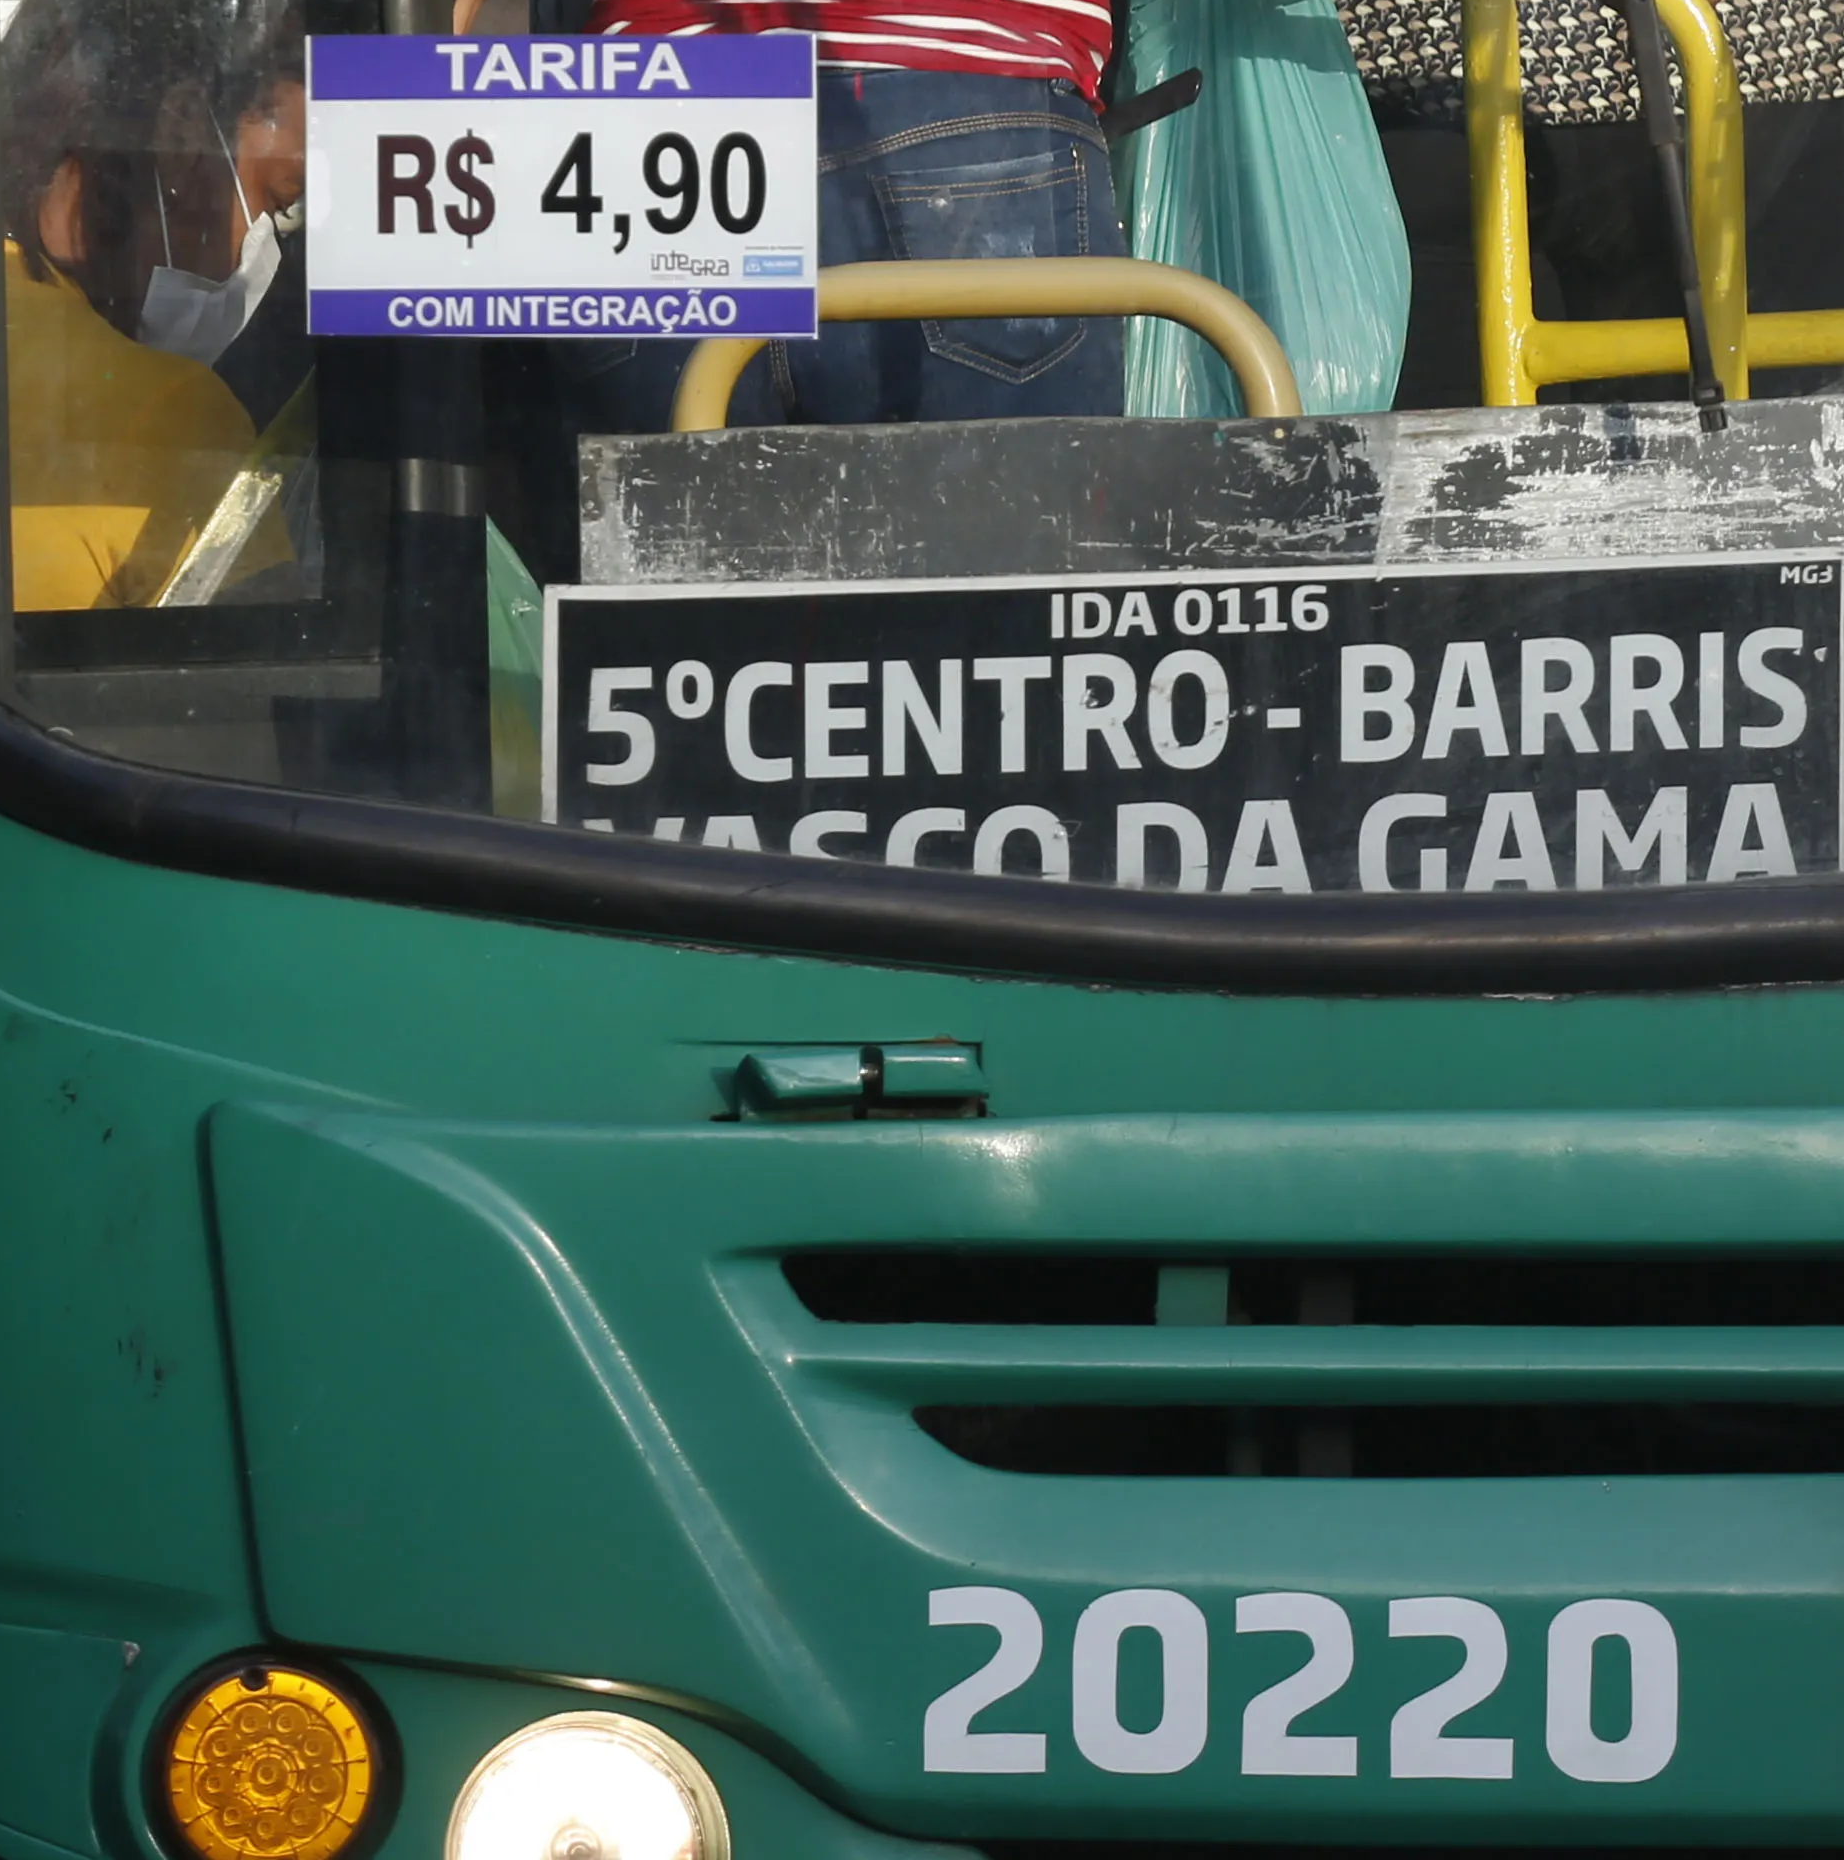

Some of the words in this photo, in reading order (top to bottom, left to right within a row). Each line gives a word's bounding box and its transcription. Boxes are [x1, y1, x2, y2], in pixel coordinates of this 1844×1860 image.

[435, 42, 691, 91] TARIFA
[376, 128, 496, 249] R$
[540, 131, 767, 255] 4,90
[387, 296, 474, 328] COM
[485, 288, 738, 333] INTEGRAÇÃO
[1050, 592, 1158, 639] IDA
[1172, 583, 1330, 636] 0116
[1339, 626, 1809, 765] BARRIS
[1115, 798, 1314, 894] DA
[1357, 781, 1799, 893] GAMA
[922, 1584, 1681, 1785] 20220
